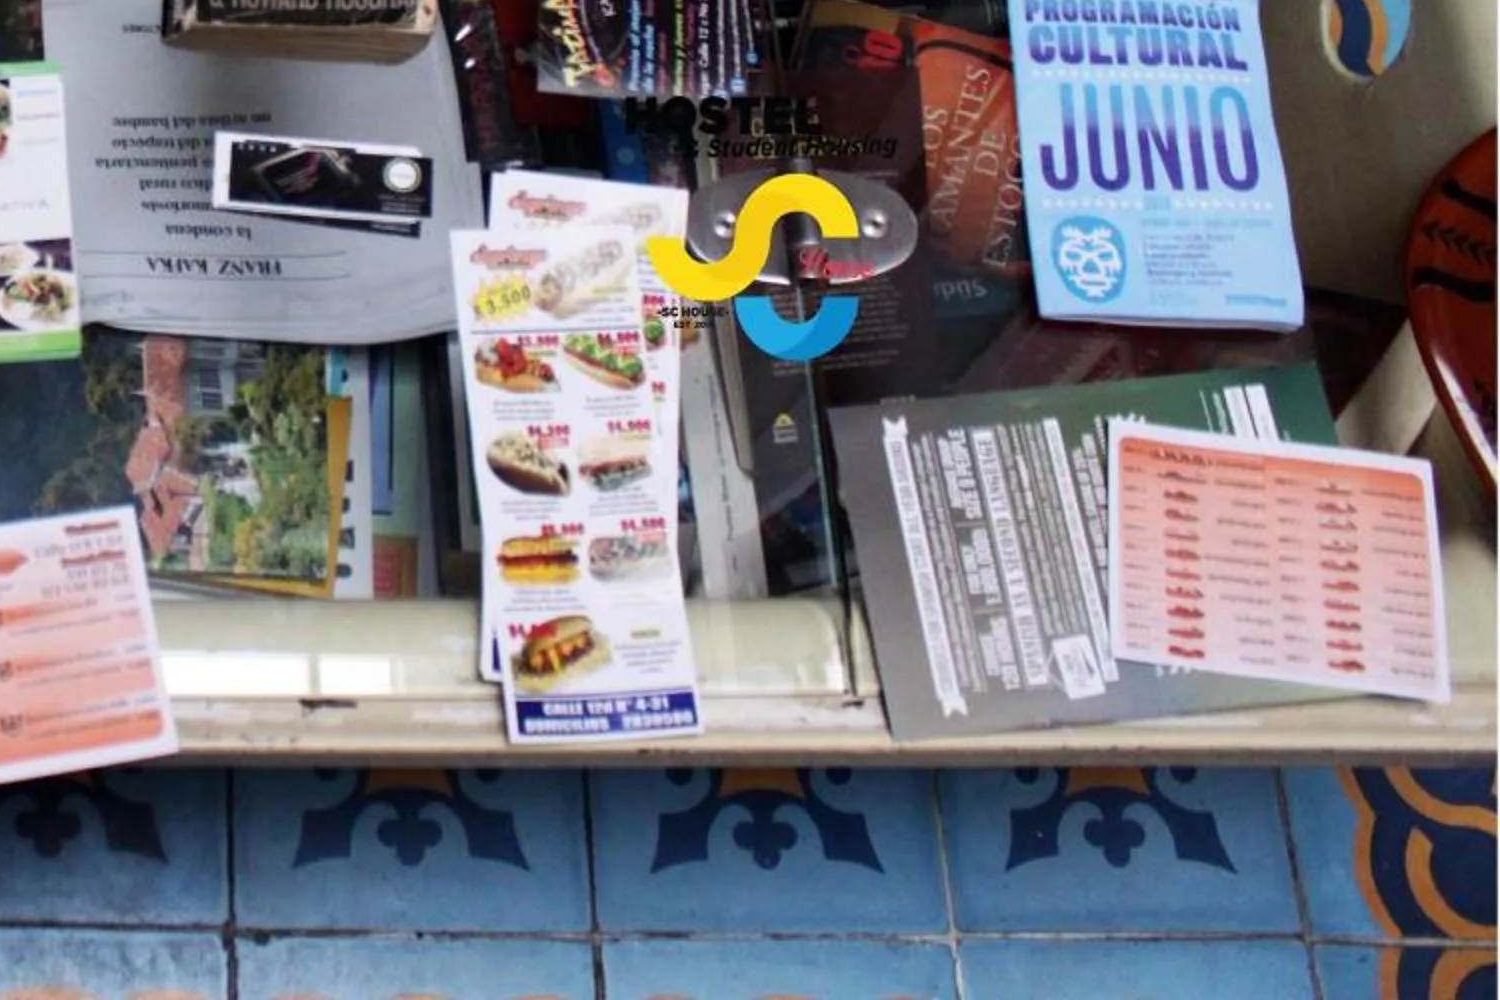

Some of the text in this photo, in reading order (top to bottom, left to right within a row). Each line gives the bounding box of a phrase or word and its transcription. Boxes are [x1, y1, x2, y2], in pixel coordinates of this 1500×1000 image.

[1028, 25, 1249, 71] CULTURAL
[112, 132, 201, 150] del trapecio
[172, 115, 196, 129] del
[921, 105, 950, 167] LOS
[929, 65, 992, 225] AMANTES
[1040, 82, 1259, 192] JUNIO
[972, 130, 1008, 175] DE
[138, 178, 177, 191] rural
[165, 224, 253, 241] la condena
[145, 257, 282, 275] FRANZ KAFKA
[949, 427, 972, 478] PEOPLE
[981, 436, 1010, 514] LANGUAGE
[995, 515, 1020, 574] SECOND
